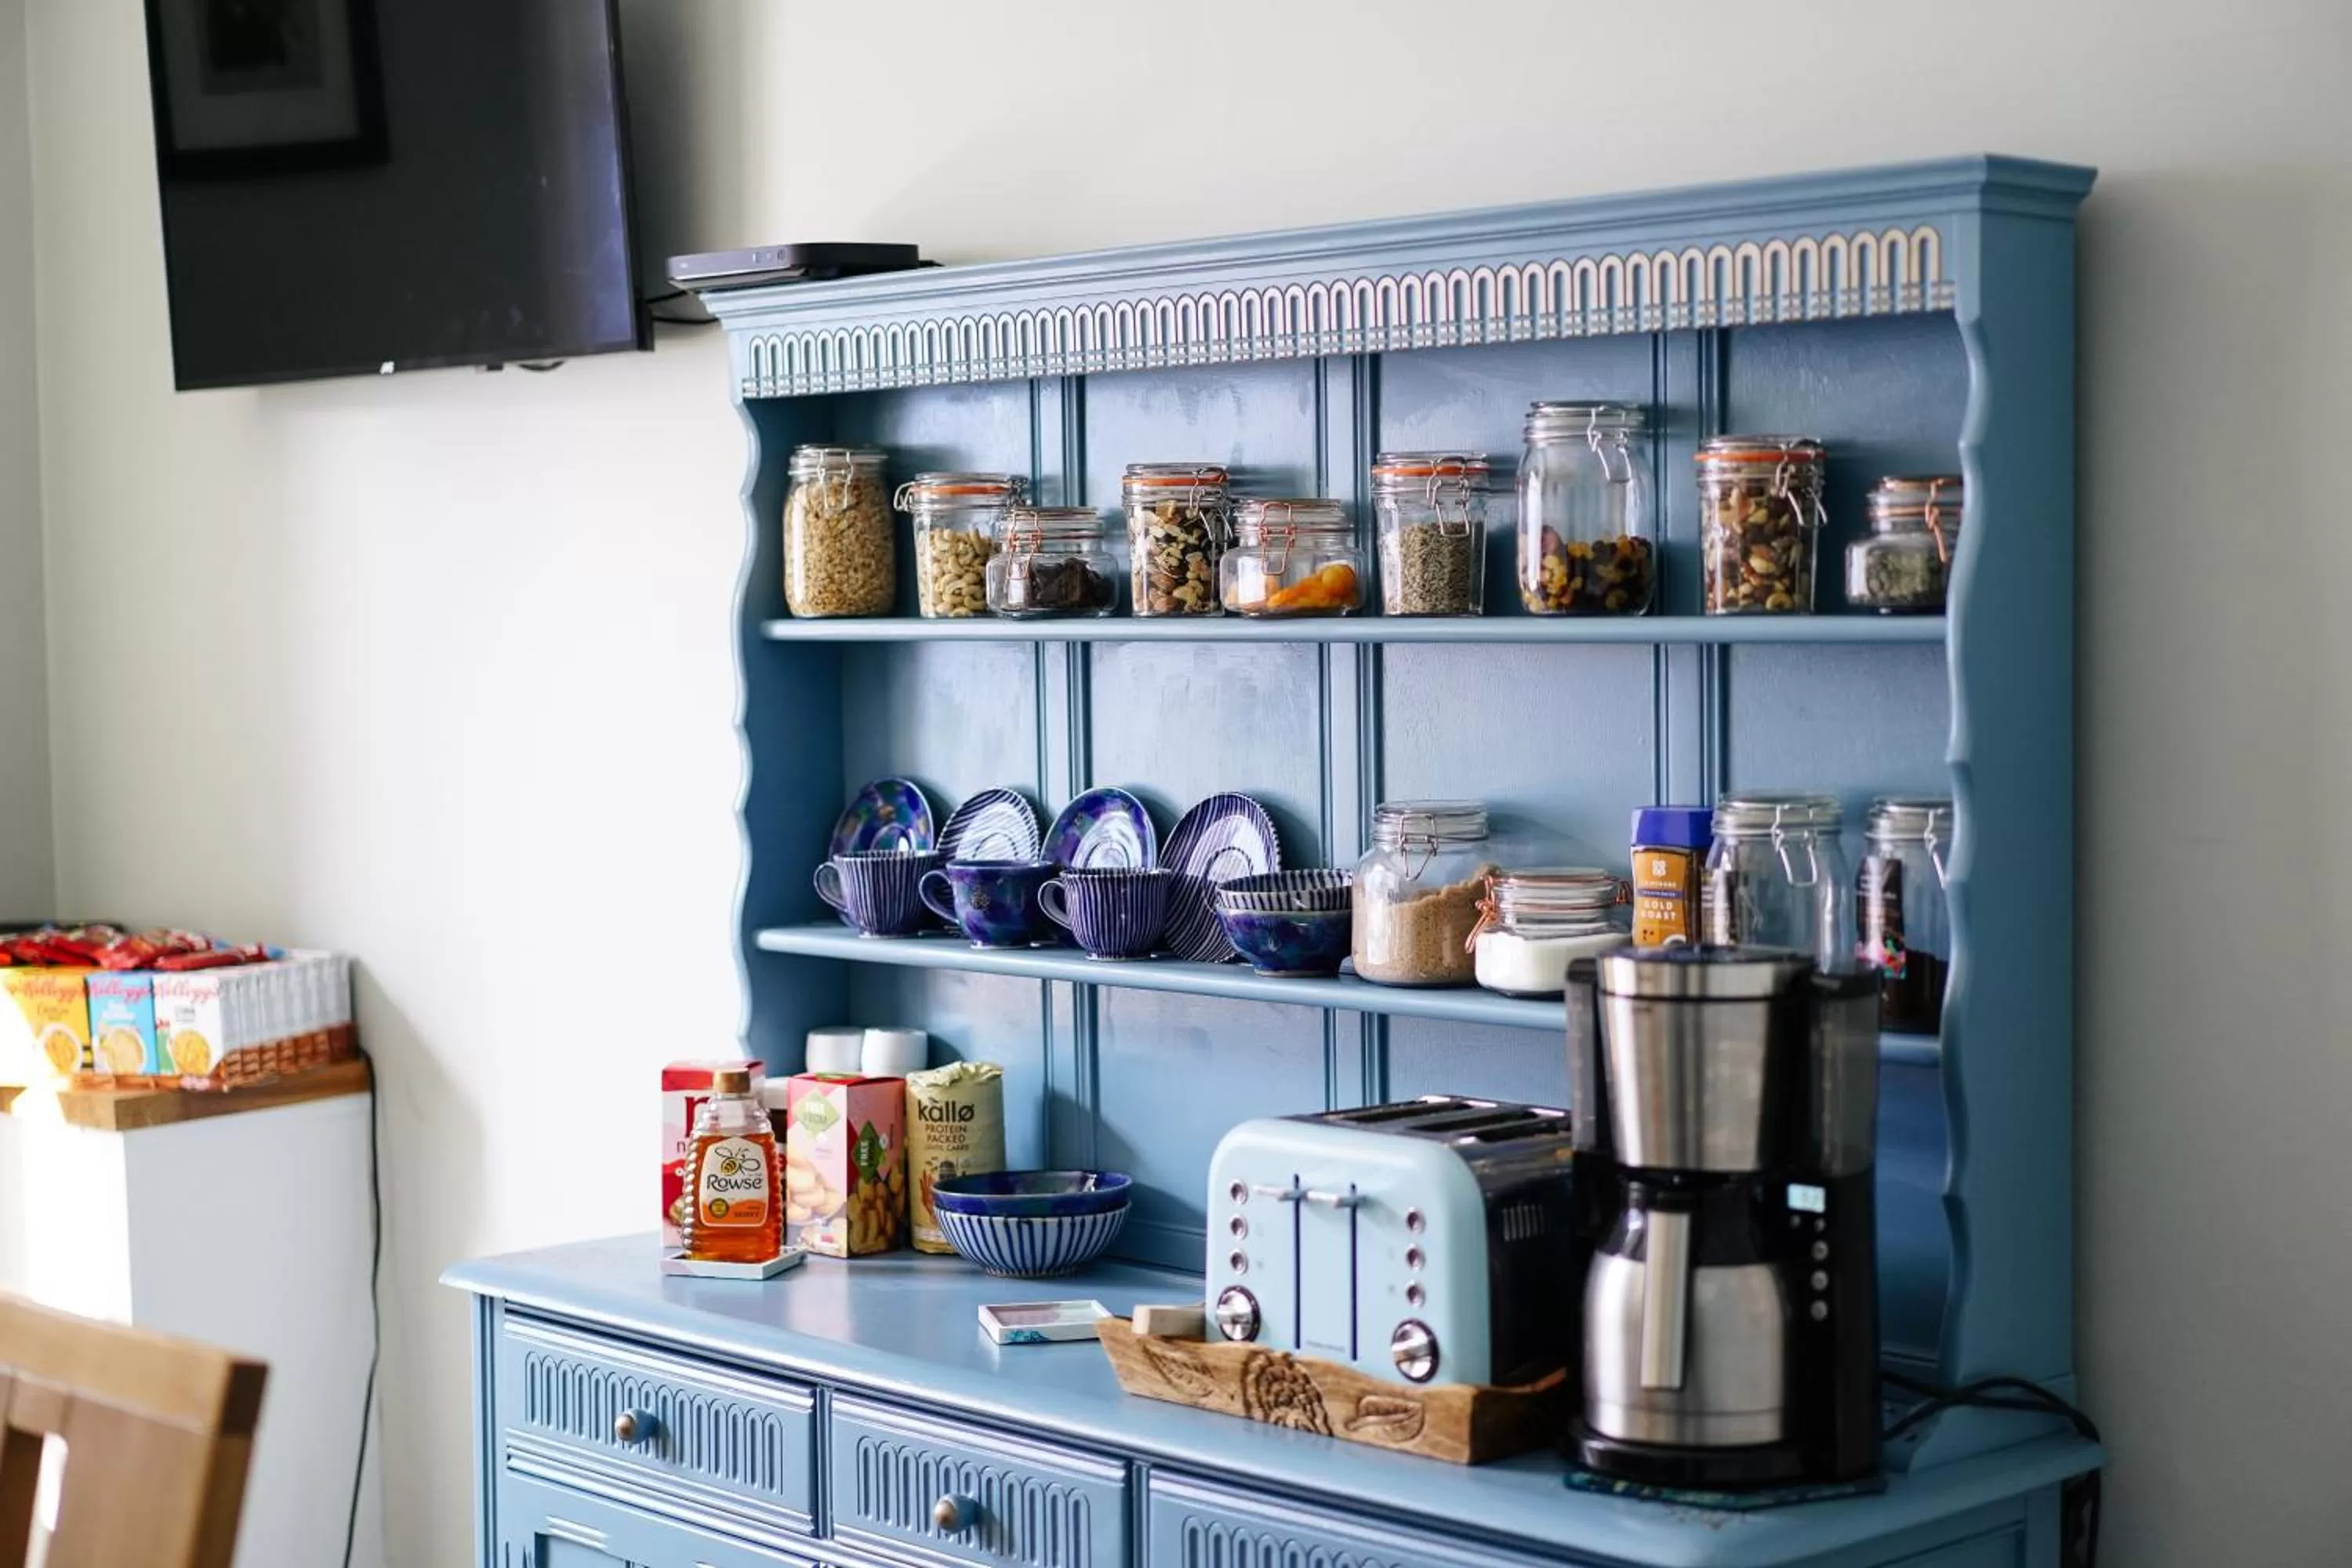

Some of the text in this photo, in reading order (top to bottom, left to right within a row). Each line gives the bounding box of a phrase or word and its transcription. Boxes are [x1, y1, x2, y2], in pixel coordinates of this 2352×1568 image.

[925, 1123, 967, 1134] PROTEIN
[927, 1133, 967, 1144] PACKED
[706, 1174, 764, 1192] Rowse
